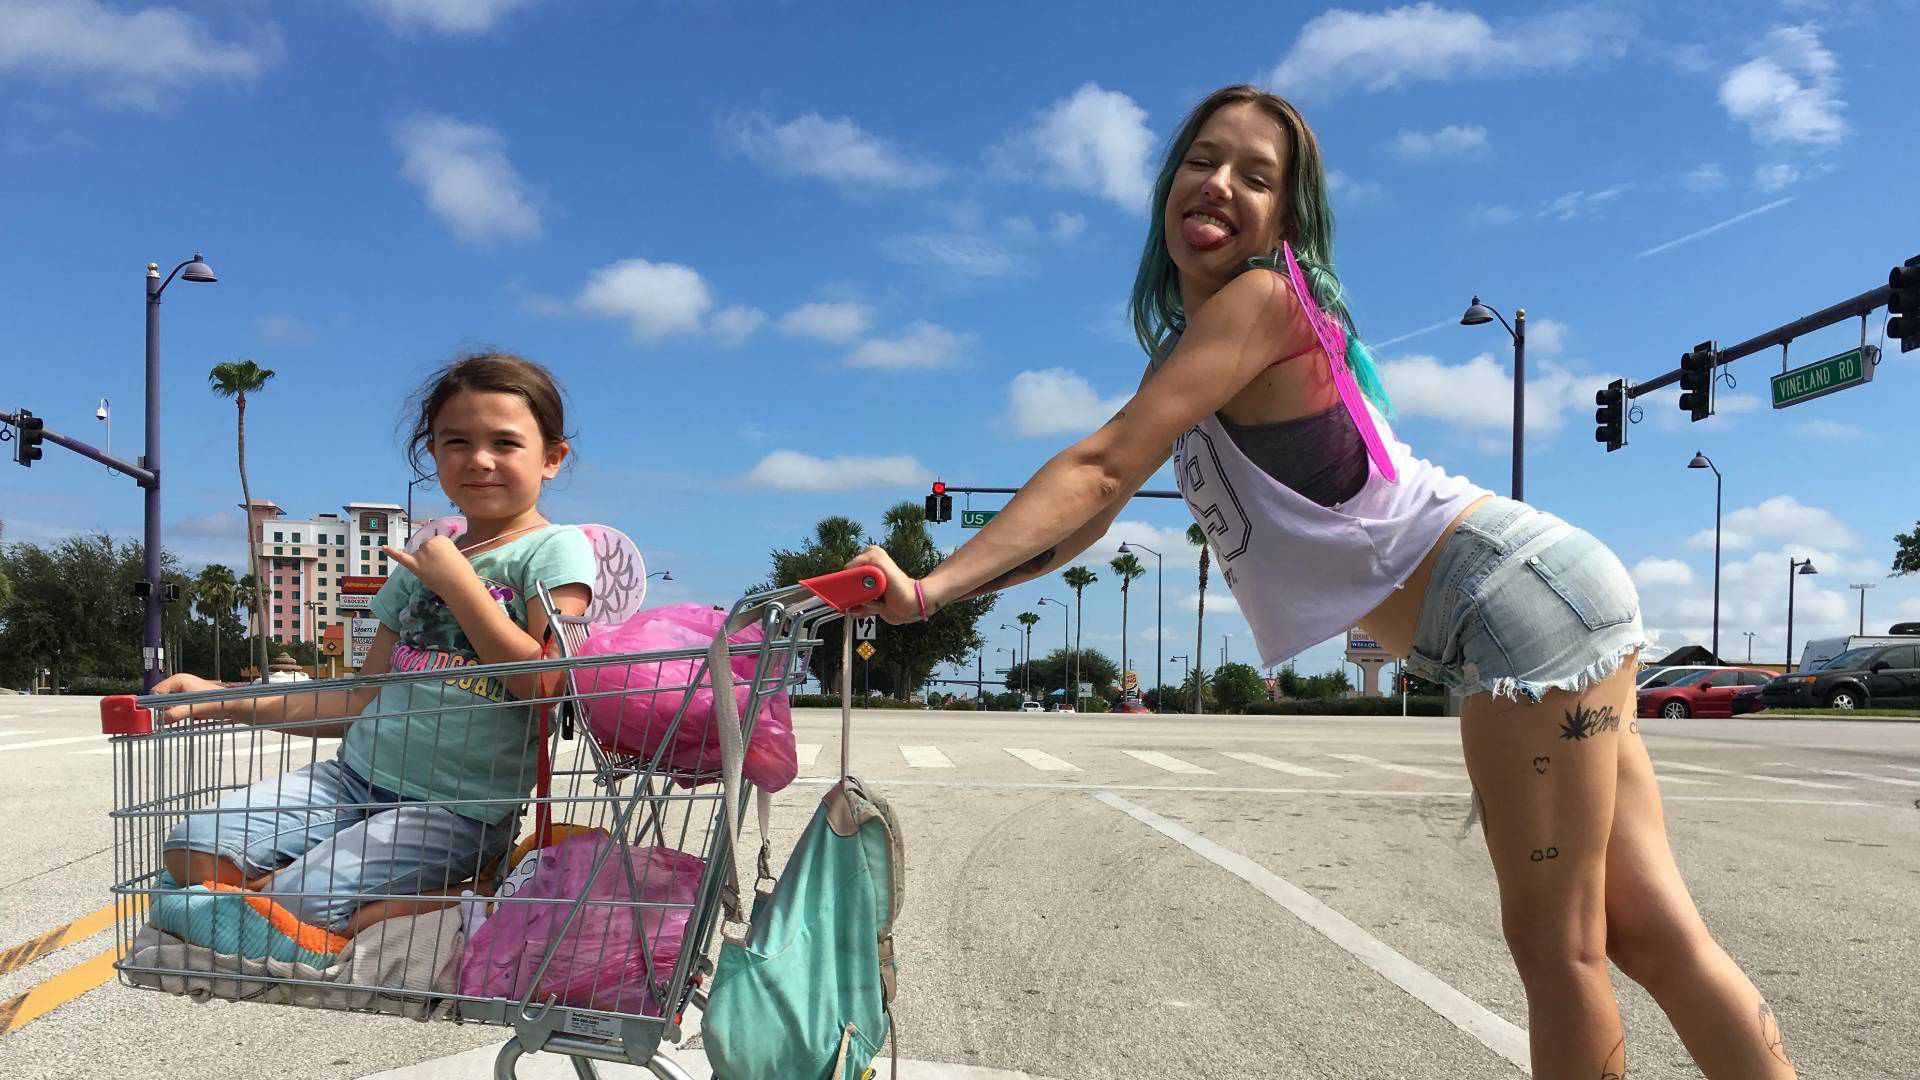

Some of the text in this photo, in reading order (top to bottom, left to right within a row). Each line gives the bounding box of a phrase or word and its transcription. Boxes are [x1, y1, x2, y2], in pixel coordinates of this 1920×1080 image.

[1780, 359, 1854, 398] VINELAND RD
[964, 513, 984, 525] US
